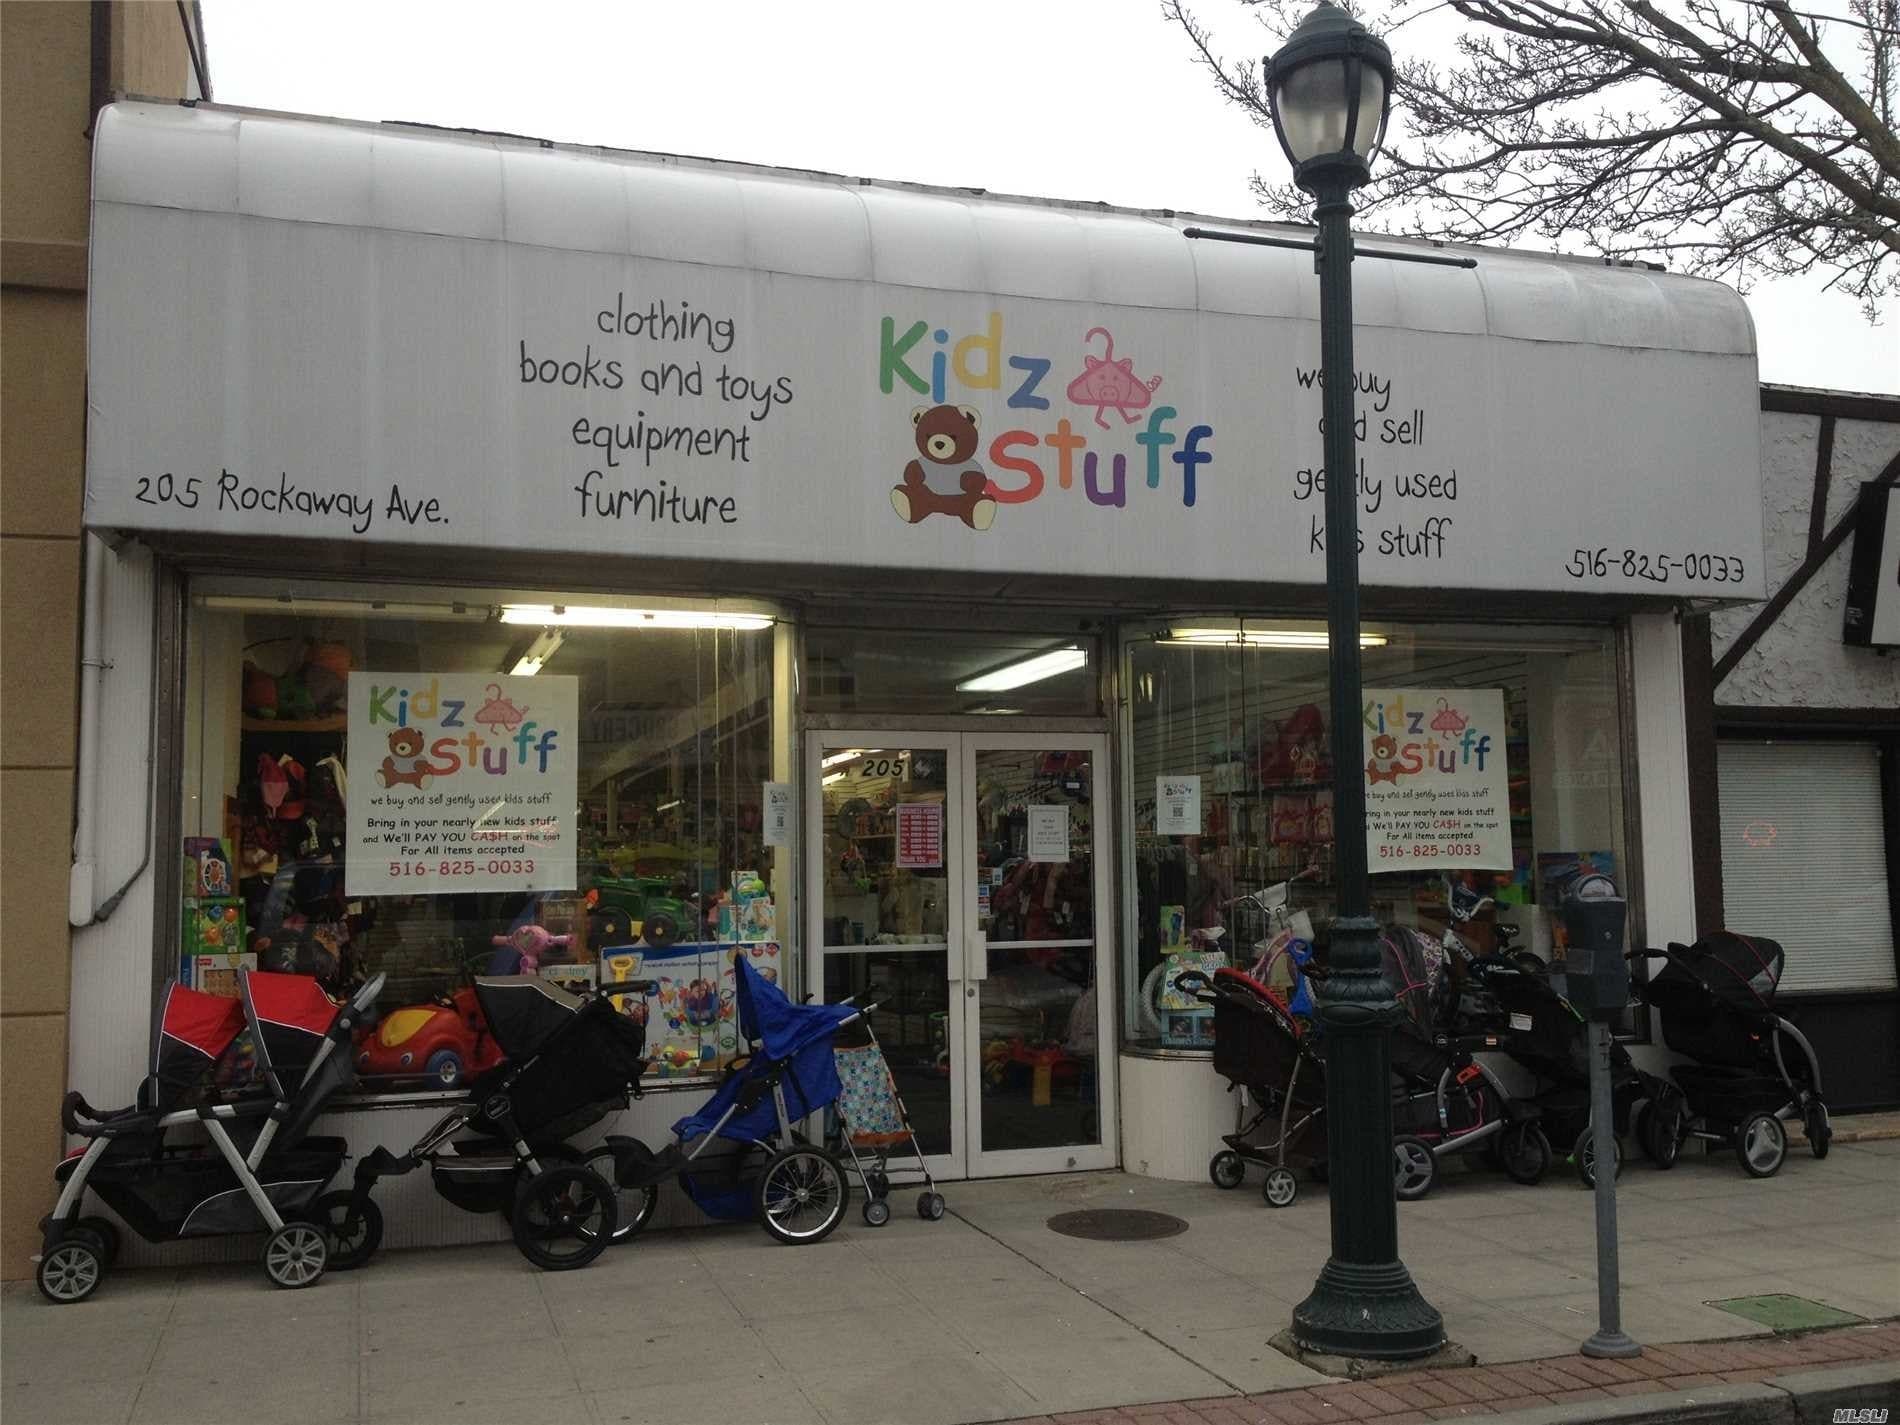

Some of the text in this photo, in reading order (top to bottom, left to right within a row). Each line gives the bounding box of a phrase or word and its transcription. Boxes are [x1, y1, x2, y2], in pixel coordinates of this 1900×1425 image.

[598, 292, 735, 353] clothing
[519, 340, 793, 421] books and toys
[879, 311, 1051, 410] Kidz
[572, 411, 751, 467] equipment
[1380, 410, 1424, 446] sell
[984, 406, 1213, 508] Stuff
[135, 469, 450, 534] 205 Rockaway Ave.
[574, 470, 738, 525] furniture
[1294, 458, 1457, 513] gely used
[1311, 515, 1453, 559] ks stuff
[1565, 548, 1745, 583] 516-825-0033
[369, 678, 465, 728] Kidz
[426, 722, 558, 776] Stuff
[862, 759, 905, 777] 205
[1400, 728, 1491, 774] Stuff
[386, 795, 404, 809] buy
[408, 796, 425, 805] and
[445, 793, 475, 808] gently
[527, 792, 553, 804] stuff
[1365, 809, 1381, 819] ring
[1393, 810, 1410, 819] your
[1413, 808, 1436, 818] nearly
[363, 834, 379, 843] and
[383, 832, 410, 843] We'll
[415, 832, 437, 842] PAY
[441, 832, 466, 842] YOU
[526, 833, 540, 841] the
[367, 818, 396, 830] Bring
[400, 817, 410, 828] in
[414, 819, 438, 829] your
[442, 816, 476, 829] nearly
[504, 816, 526, 826] kids
[1413, 821, 1430, 830] YOU
[1438, 831, 1474, 841] accepted
[389, 859, 534, 876] 516-825-0033
[401, 846, 420, 855] For
[424, 845, 439, 855] All
[477, 844, 525, 856] accepted
[1380, 844, 1481, 858] 516-825-0033
